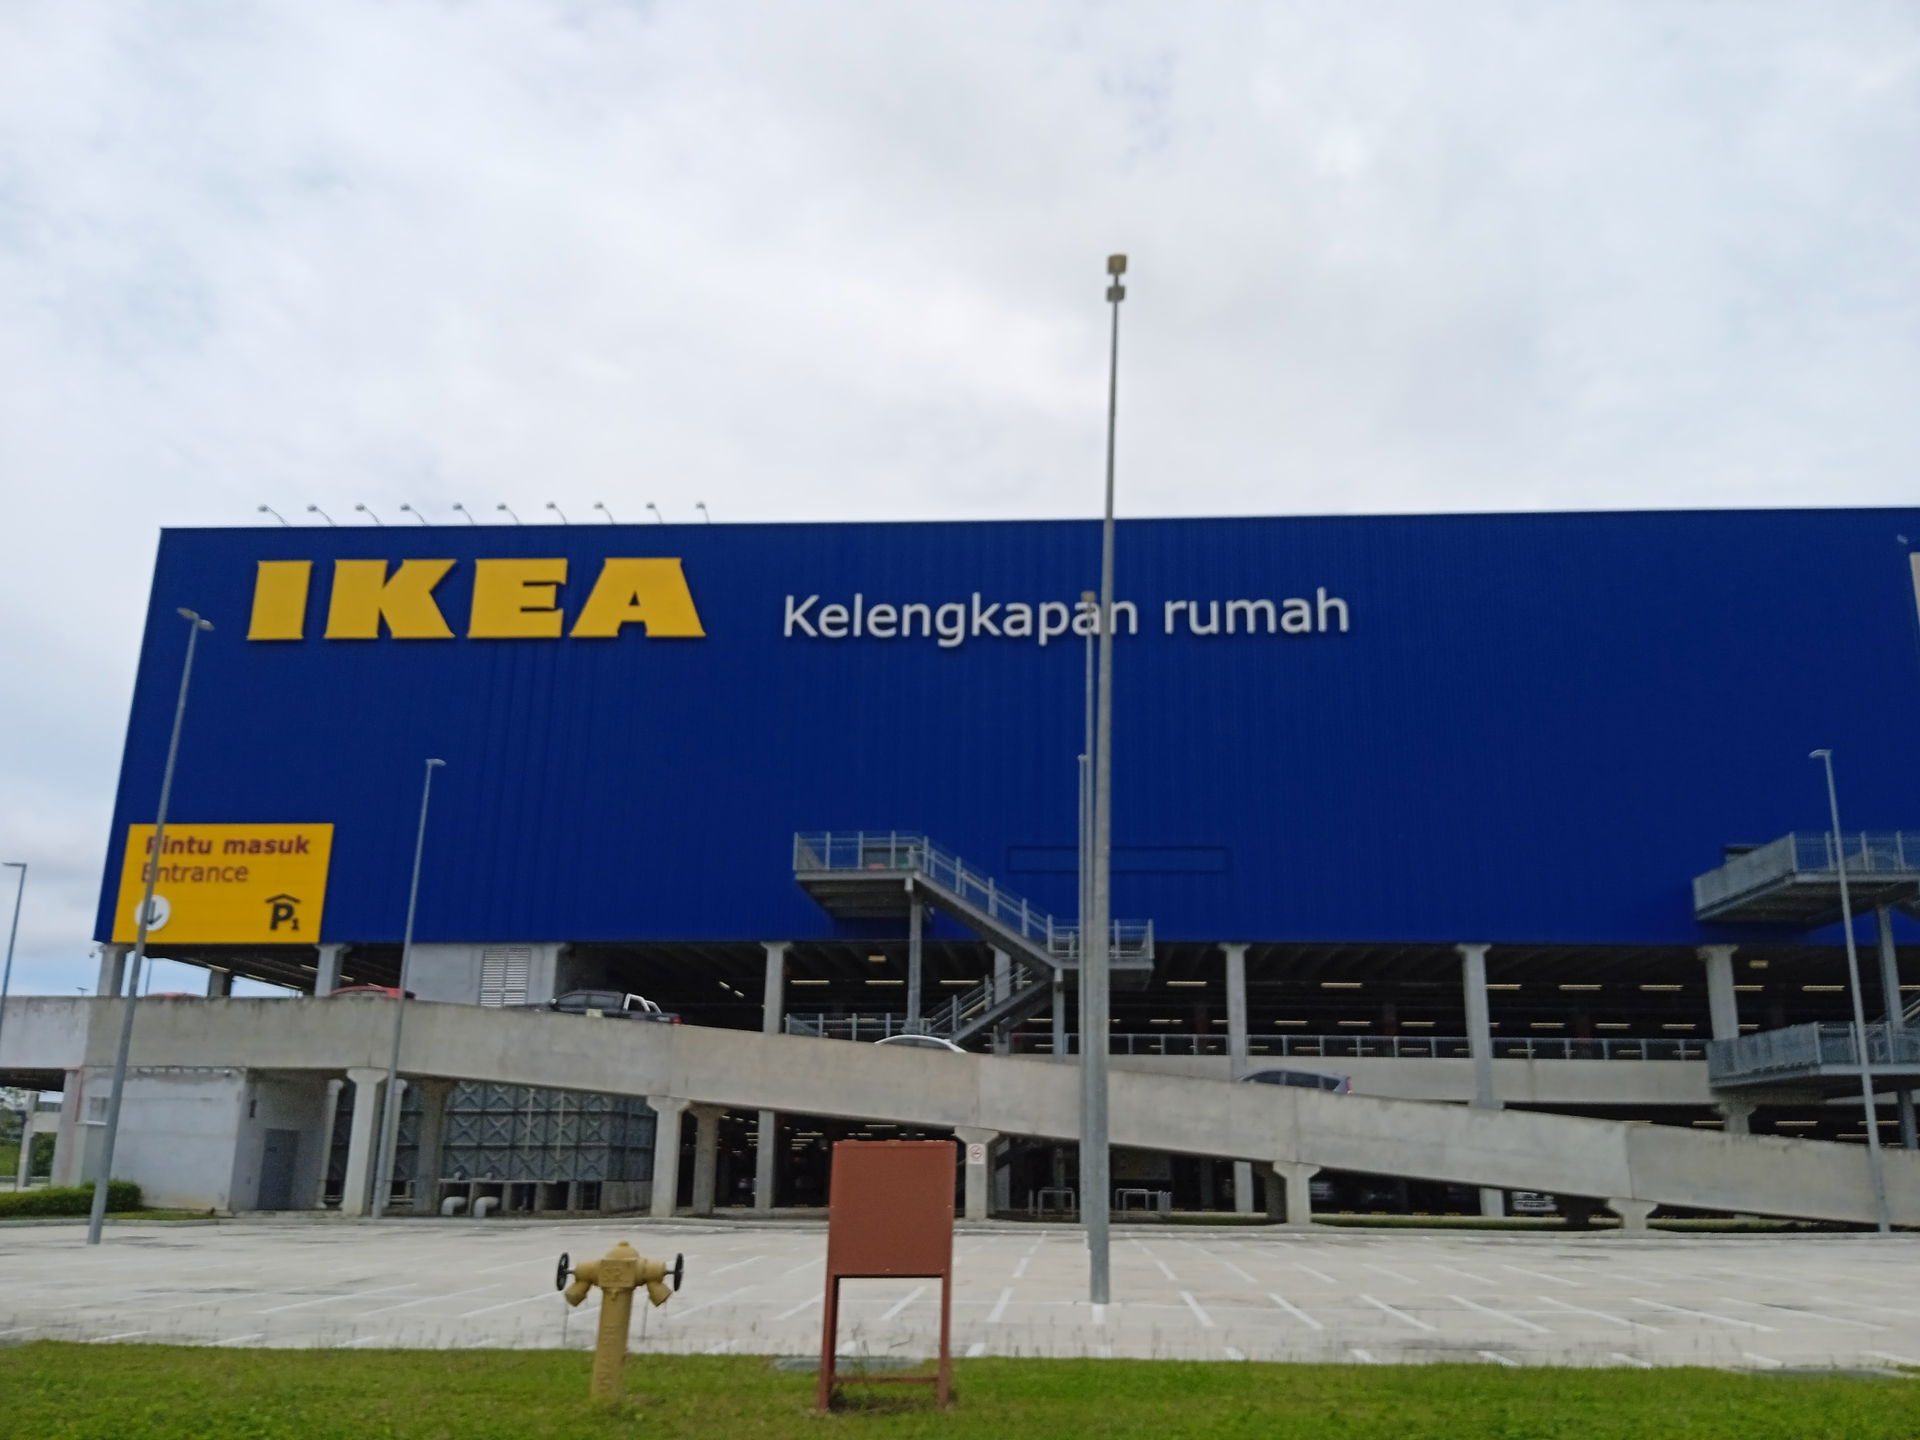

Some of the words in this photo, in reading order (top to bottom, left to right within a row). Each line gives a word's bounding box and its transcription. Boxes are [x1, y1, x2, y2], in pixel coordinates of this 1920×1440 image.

[247, 557, 705, 640] IKEA
[783, 592, 1138, 648] Kelengkapan
[1165, 587, 1349, 635] rumah
[222, 835, 310, 855] masuk
